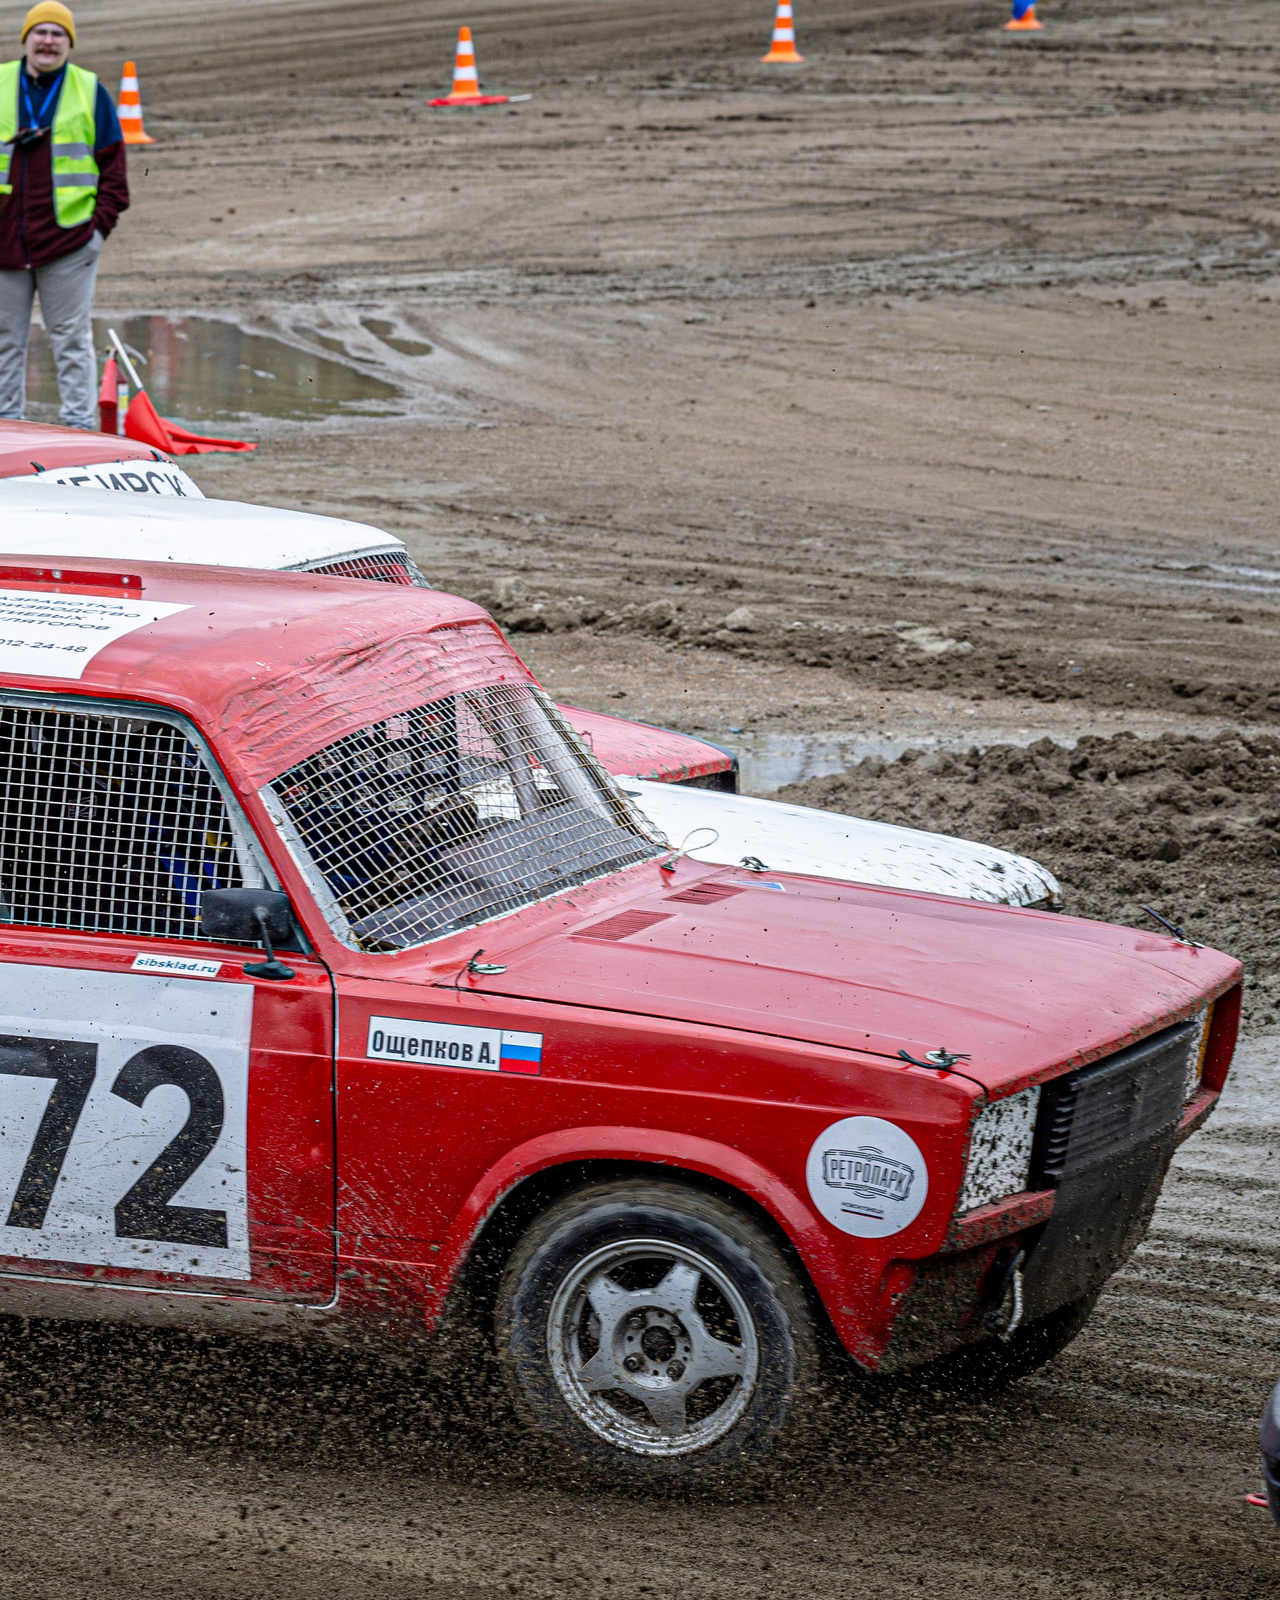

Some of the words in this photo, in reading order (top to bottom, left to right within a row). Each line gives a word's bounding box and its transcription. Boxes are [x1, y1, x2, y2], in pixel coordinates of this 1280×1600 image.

[136, 958, 217, 973] sibsklad.ru
[372, 1029, 473, 1062] Ощепков
[477, 1041, 496, 1065] А.
[830, 1158, 907, 1193] РЕТРОПАРК
